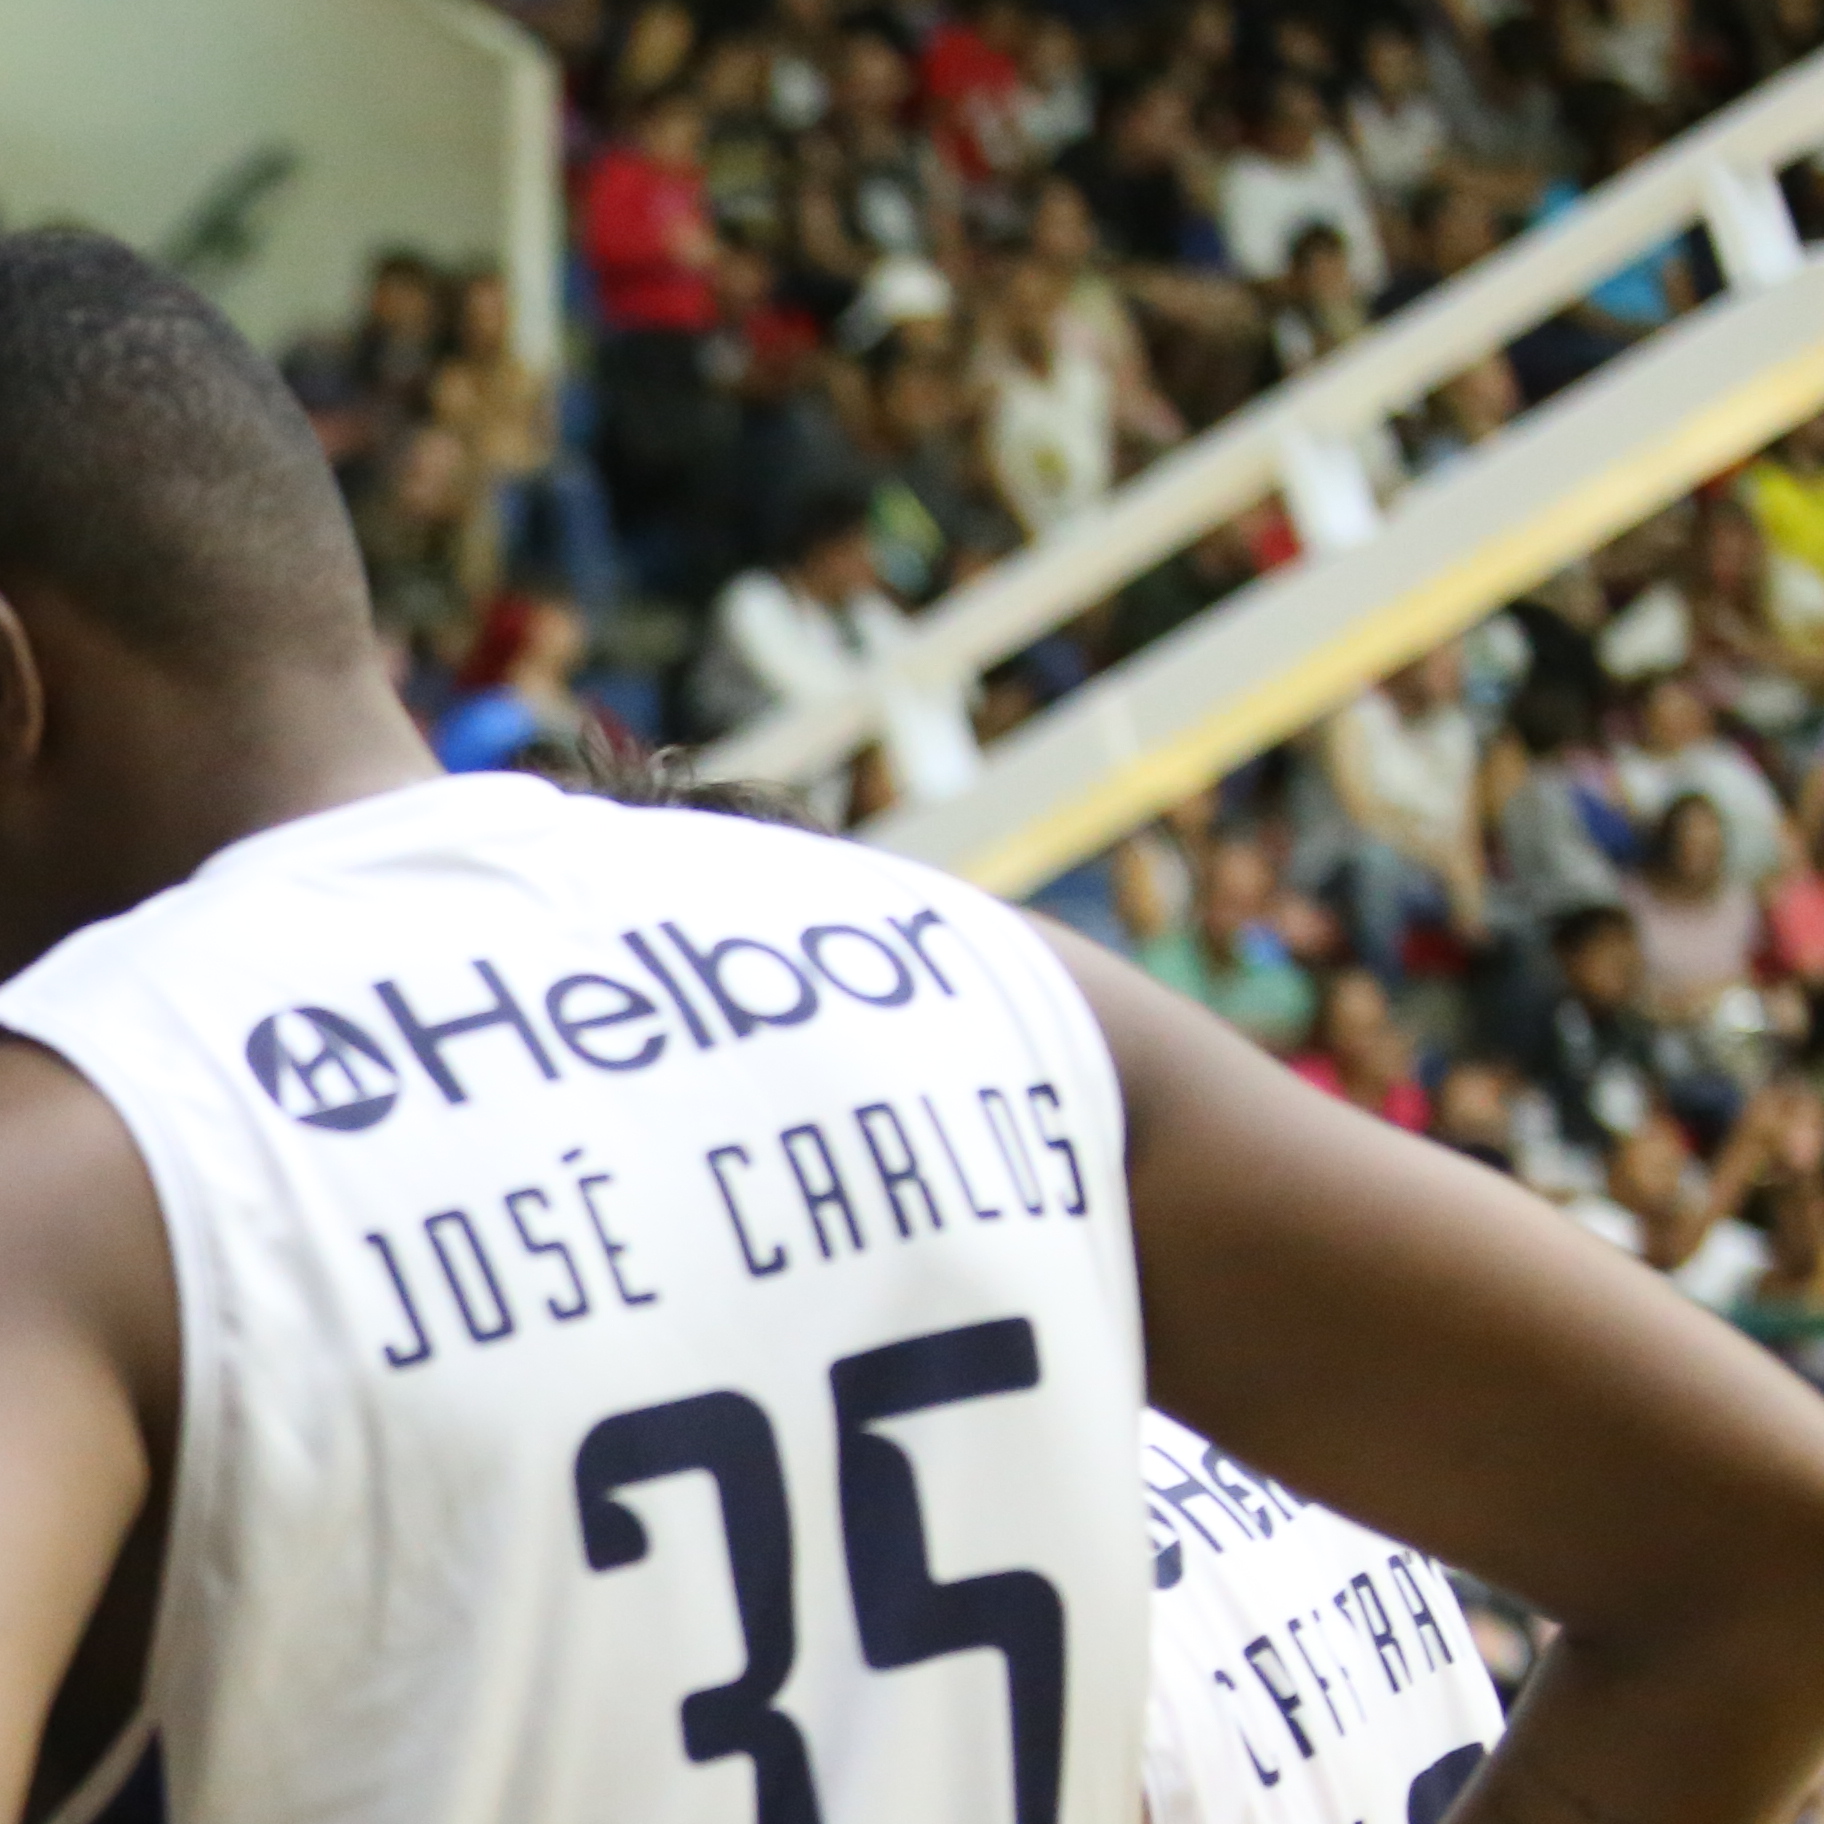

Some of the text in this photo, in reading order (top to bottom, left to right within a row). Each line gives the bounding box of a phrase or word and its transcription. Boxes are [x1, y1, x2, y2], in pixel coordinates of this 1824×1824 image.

[374, 908, 957, 1105] Helbor
[365, 1083, 1089, 1368] JOSÉ CARLOS
